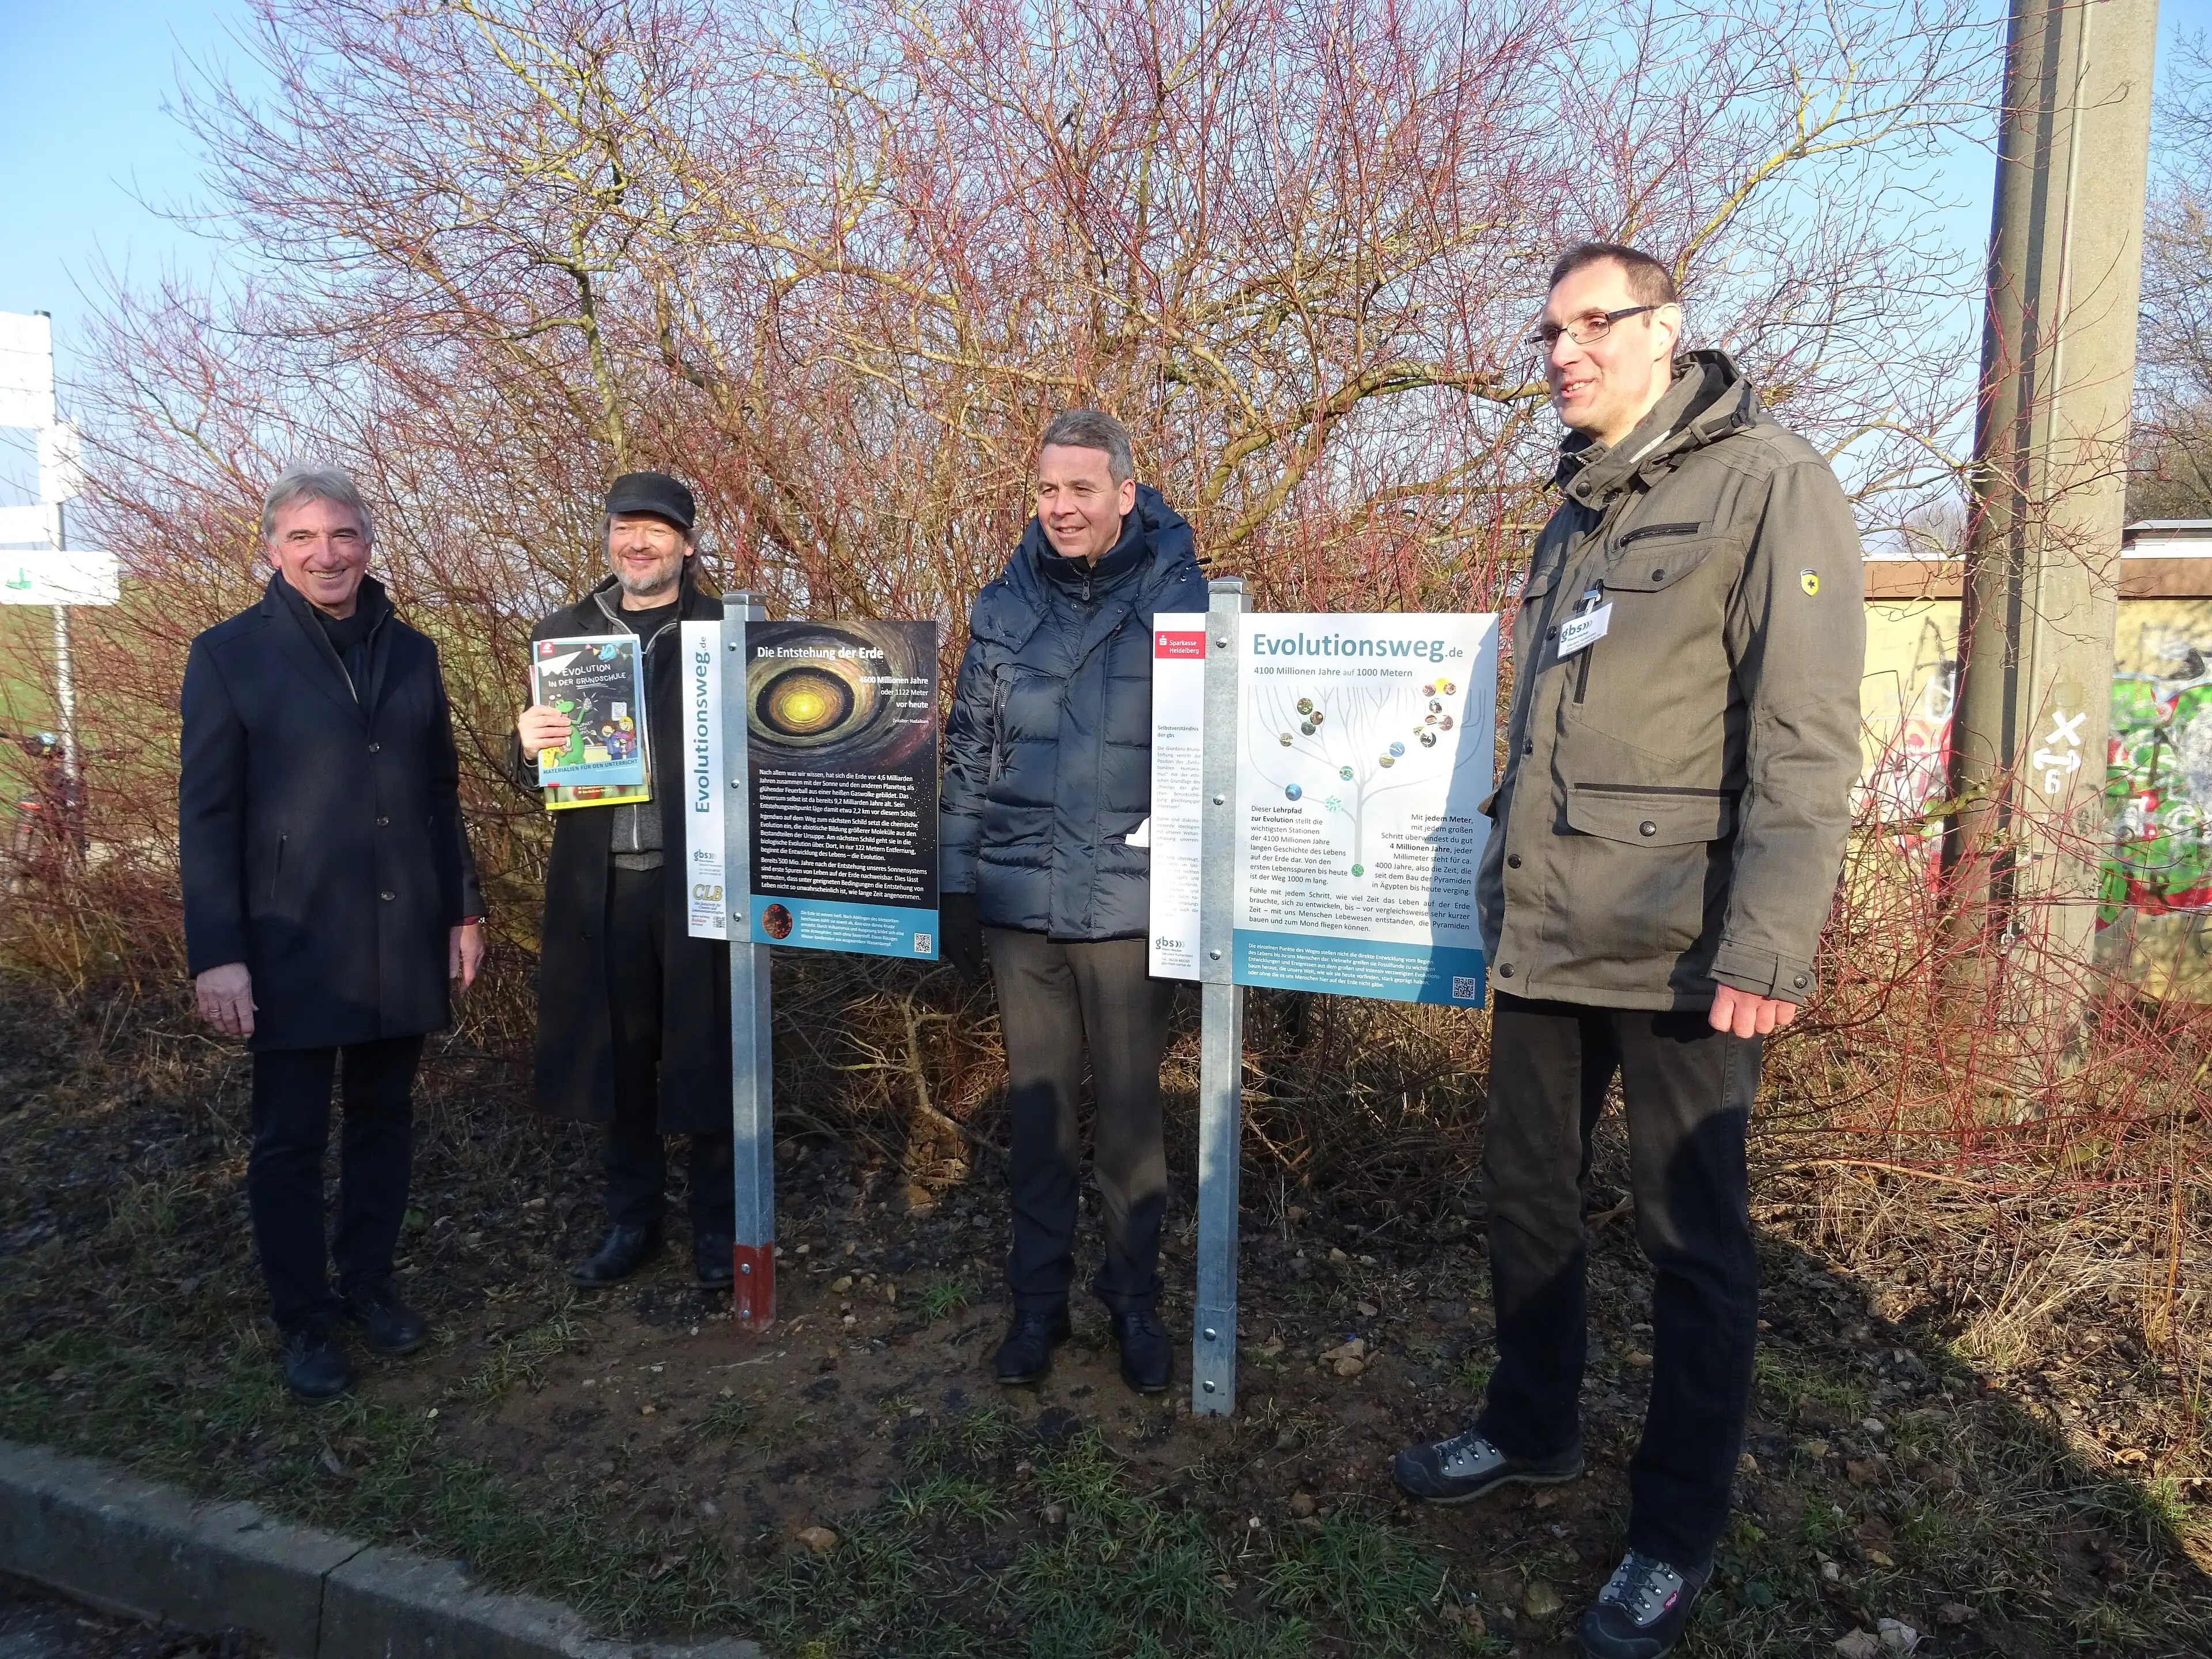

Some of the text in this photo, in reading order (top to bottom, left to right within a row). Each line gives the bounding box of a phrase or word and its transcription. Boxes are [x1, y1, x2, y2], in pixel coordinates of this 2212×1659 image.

[1169, 647, 1200, 655] Heidelberg
[1253, 631, 1464, 663] Evolutionsweg.de
[757, 646, 884, 661] Die Entstehung der Erde
[562, 664, 611, 676] EVOLUTION
[1276, 667, 1315, 675] Millionen
[559, 678, 574, 687] DER
[576, 672, 626, 685] GRUNDSCHULE
[910, 676, 929, 684] Jahre
[693, 636, 710, 813] Evolutionsweg.de
[543, 766, 579, 775] MATERIALIEN
[605, 759, 638, 768] UNTERRICHT
[1273, 806, 1302, 815] Lehrpfad
[1425, 815, 1449, 823] jedem
[1449, 816, 1474, 824] Meter,
[1251, 825, 1319, 835] wichtigsten Stationen
[1424, 824, 1446, 834] jedem
[1448, 825, 1473, 835] großen
[1405, 834, 1449, 842] überwindest
[1461, 838, 1473, 846] gut
[760, 838, 787, 847] biologische
[885, 846, 916, 855] Entfernung,
[1250, 844, 1271, 853] langen
[1273, 846, 1308, 854] Geschichte
[1396, 843, 1429, 851] Millionen
[1431, 845, 1452, 854] Jahre,
[1454, 846, 1472, 855] jeder
[694, 849, 709, 862] gbs
[1393, 853, 1429, 861] Millimeter
[785, 867, 802, 875] Spuren
[860, 872, 893, 880] nachweisbar.
[1271, 865, 1316, 875] Lebensspuren
[1393, 863, 1414, 872] Jahre,
[1444, 866, 1458, 874] Zeit,
[1271, 874, 1285, 883] Weg
[1311, 877, 1328, 886] lang.
[1434, 876, 1471, 886] Pyramiden
[692, 884, 723, 902] CLB
[1380, 881, 1408, 892] Ägypten
[1421, 885, 1441, 893] heute
[1443, 887, 1471, 896] verging.
[1298, 919, 1319, 927] Mond
[1319, 921, 1342, 930] fliegen
[1344, 923, 1370, 931] können.
[1155, 935, 1174, 951] gbs
